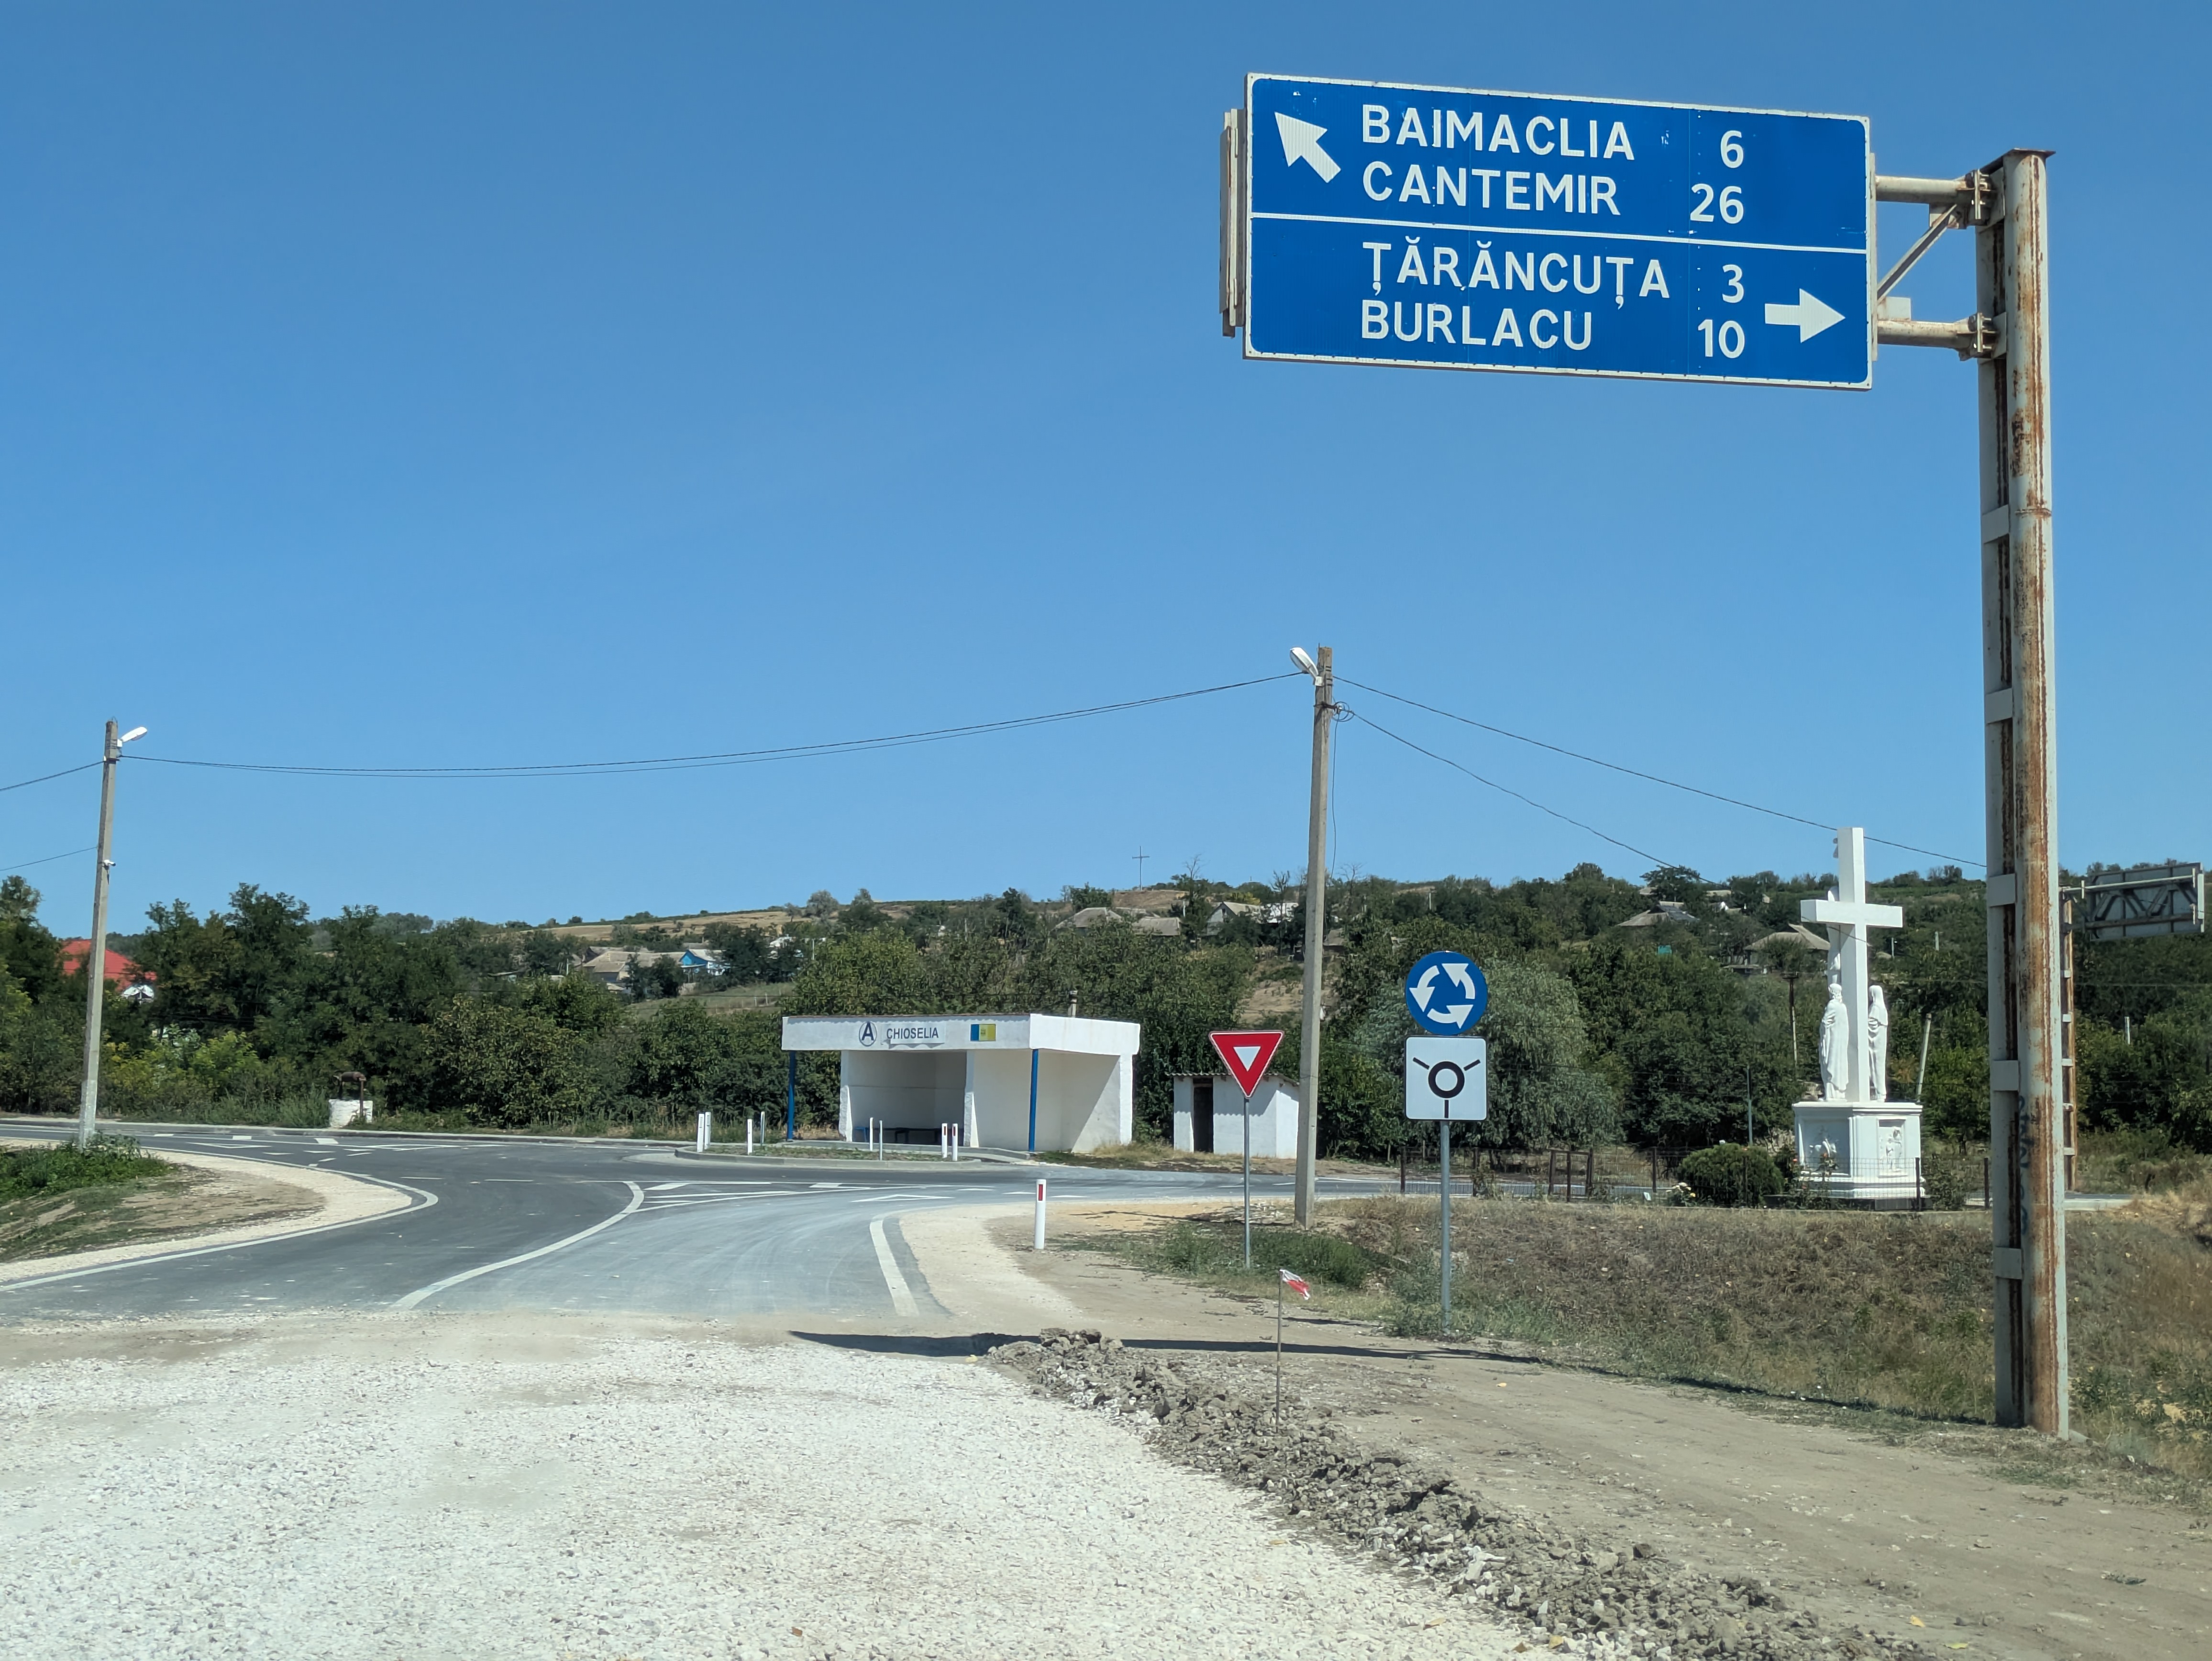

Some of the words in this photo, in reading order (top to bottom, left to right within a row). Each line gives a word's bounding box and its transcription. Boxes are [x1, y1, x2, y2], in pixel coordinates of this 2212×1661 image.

[1362, 104, 1635, 161] BAIMACLIA
[1720, 130, 1744, 168] 6
[1362, 161, 1621, 216] CANTEMIR
[1690, 183, 1744, 224] 26
[1362, 235, 1670, 309] ȚĂRĂNCUȚA
[1722, 264, 1745, 303] 3
[1361, 299, 1592, 351] BURLACU
[1698, 319, 1745, 359] 10
[886, 1028, 939, 1039] CHIOSELIA
